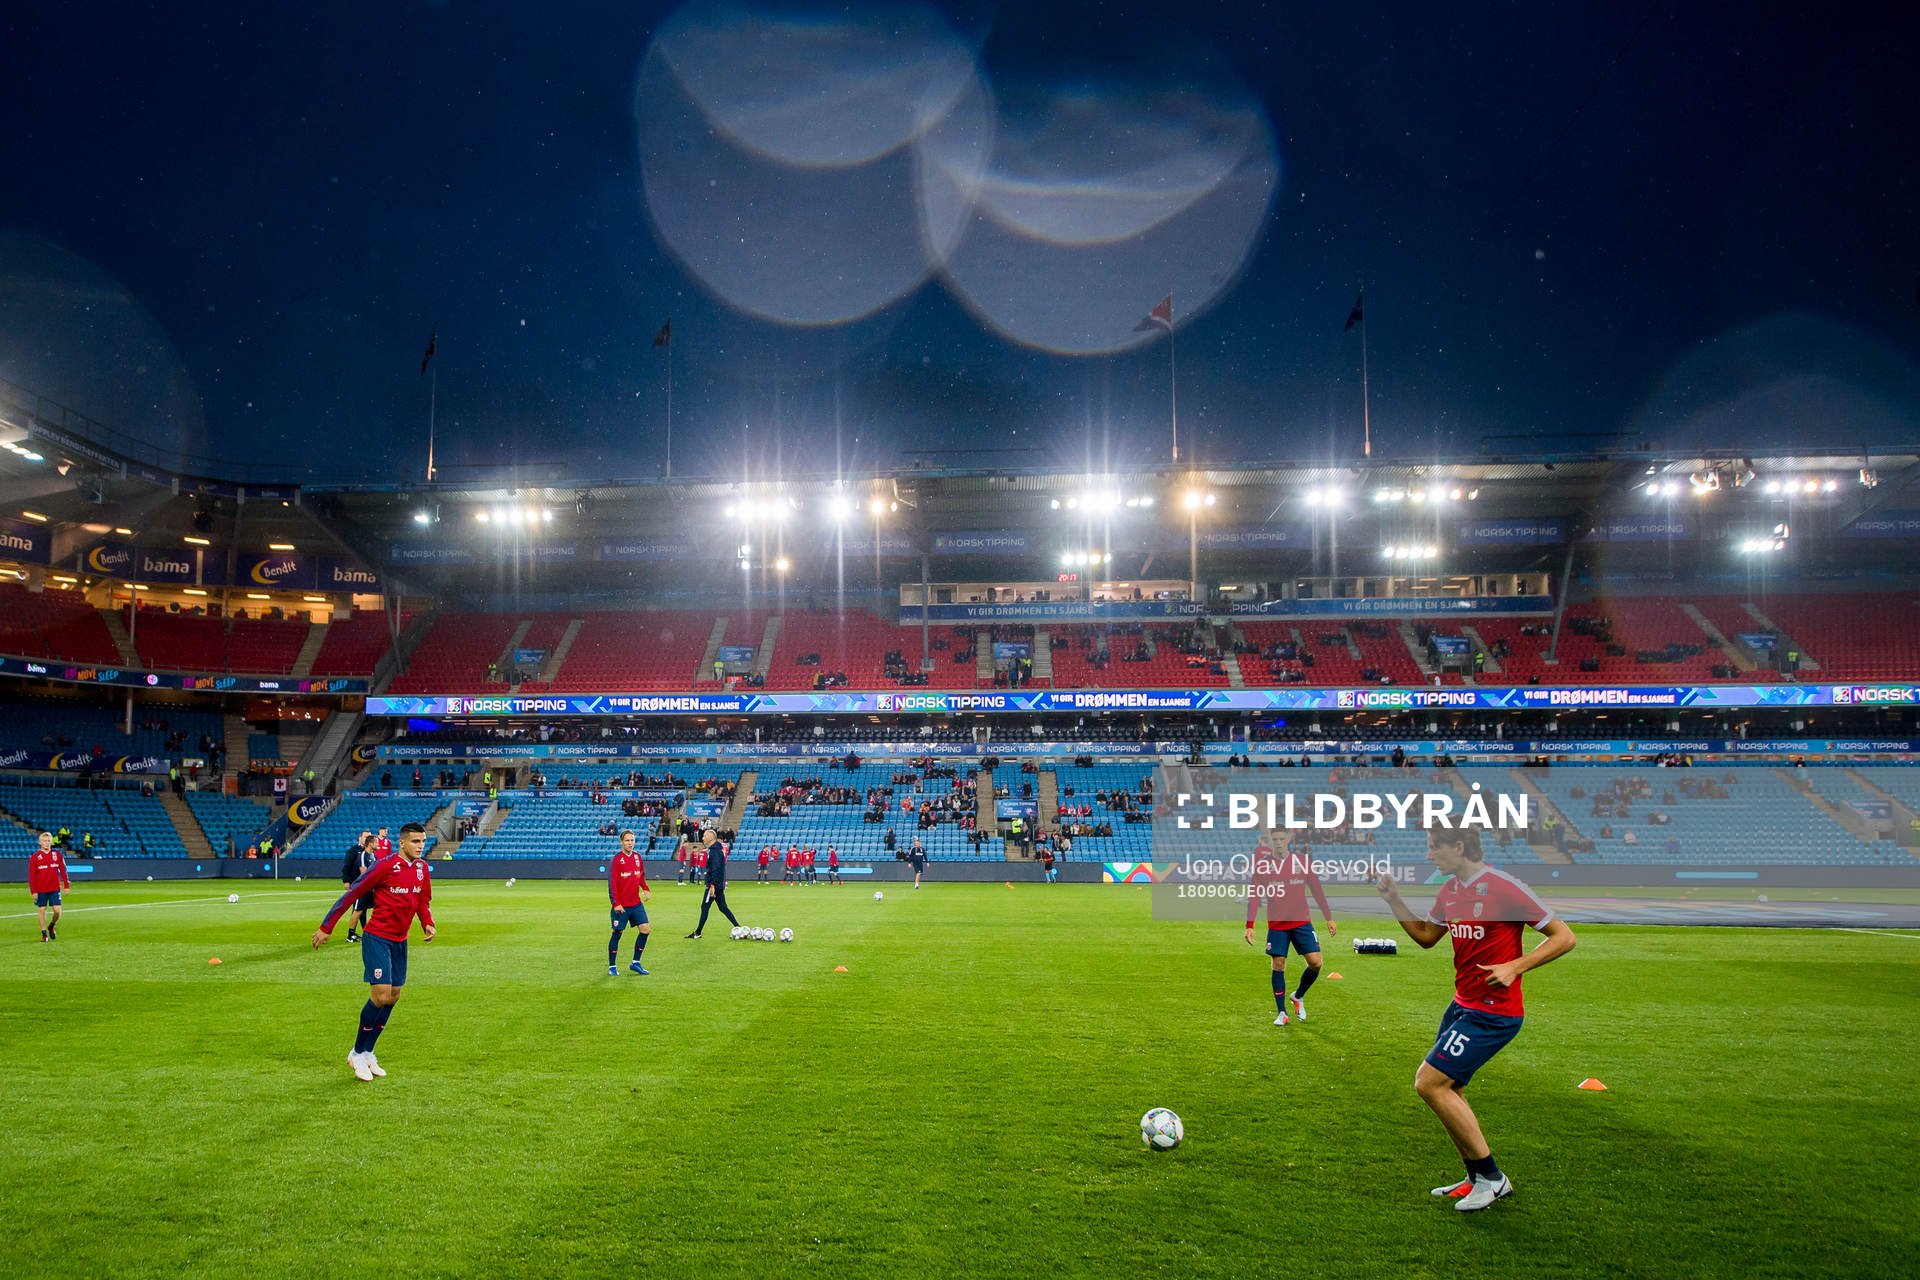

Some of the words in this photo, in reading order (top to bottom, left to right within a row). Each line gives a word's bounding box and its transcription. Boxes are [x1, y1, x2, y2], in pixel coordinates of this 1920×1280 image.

[1898, 520, 1920, 529] TIPP
[1475, 528, 1512, 537] NORSK
[0, 535, 33, 551] ama
[949, 539, 984, 548] NORSK
[986, 538, 1025, 547] TIPPING
[438, 551, 472, 559] TIPPIN
[649, 545, 683, 554] TIPPIN
[143, 557, 190, 573] bama
[263, 560, 297, 578] Bendit
[333, 567, 376, 583] bama
[978, 607, 994, 616] GIR
[996, 606, 1043, 616] DRØMMEN
[1044, 606, 1057, 616] EN
[1058, 606, 1094, 616] SJANSE
[77, 667, 97, 681] MOVE
[98, 668, 119, 682] SLEEP
[195, 676, 214, 689] MOVE
[215, 677, 236, 690] SLEEP
[259, 680, 279, 689] bama
[310, 679, 328, 692] MOVE
[329, 679, 348, 692] SLEEP
[1075, 693, 1148, 708] DRØMMEN
[1148, 698, 1159, 706] EN
[1160, 698, 1191, 706] SJANSE
[1357, 693, 1413, 705] NORSK
[1413, 692, 1476, 704] TIPPING
[1534, 690, 1549, 699] GIR
[1550, 689, 1629, 705] DRØMMEN
[1629, 695, 1642, 703] EN
[1854, 688, 1915, 701] NORSK
[464, 699, 512, 711] NORSK
[513, 699, 567, 711] TIPPING
[632, 697, 699, 712] DRØMMEN
[700, 702, 711, 710] EN
[711, 701, 740, 710] SJANSE
[895, 697, 947, 708] NORSK
[948, 696, 1005, 708] TIPPING
[394, 747, 422, 755] NORSK
[423, 747, 452, 755] TIPPING
[475, 747, 500, 755] NORSK
[501, 747, 534, 755] TIPPING
[726, 746, 754, 754] NORSK
[755, 746, 787, 754] TIPPING
[898, 745, 928, 753] NORSK
[929, 745, 961, 753] TIPPING
[986, 745, 1016, 753] NORSK
[1017, 745, 1050, 753] TIPPING
[1258, 744, 1289, 752] NORSK
[1445, 743, 1478, 751] NORSK
[1479, 743, 1514, 751] TIPPING
[1836, 742, 1870, 750] NORSK
[1871, 742, 1909, 750] TIPPING
[1449, 921, 1485, 940] ama
[1443, 1029, 1470, 1056] 15
